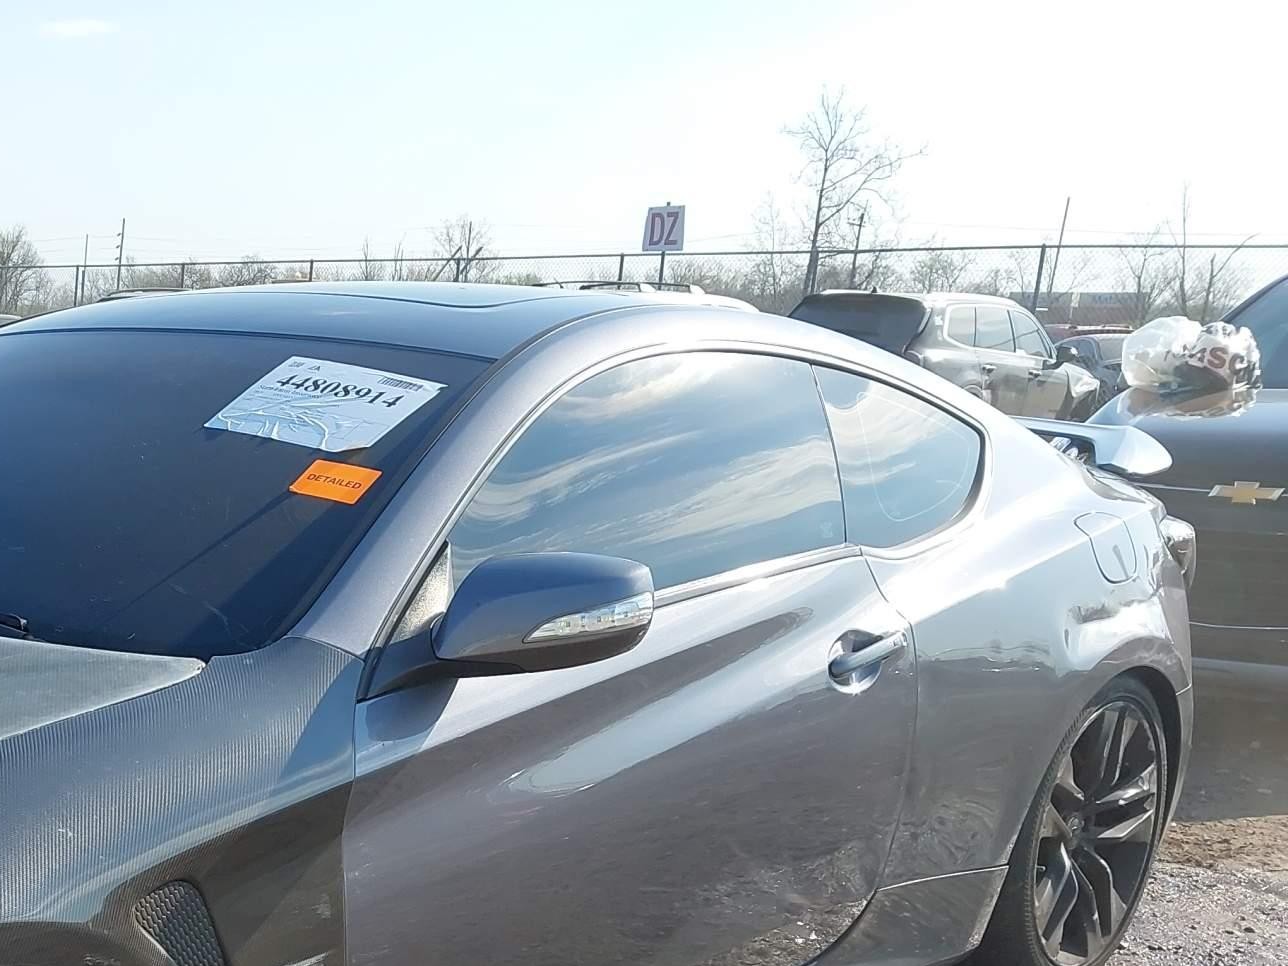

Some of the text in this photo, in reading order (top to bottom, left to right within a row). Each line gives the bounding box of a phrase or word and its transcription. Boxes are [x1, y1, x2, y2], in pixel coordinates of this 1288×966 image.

[648, 211, 680, 246] DZ
[276, 373, 406, 408] 44808914
[306, 473, 363, 490] DETAILED
